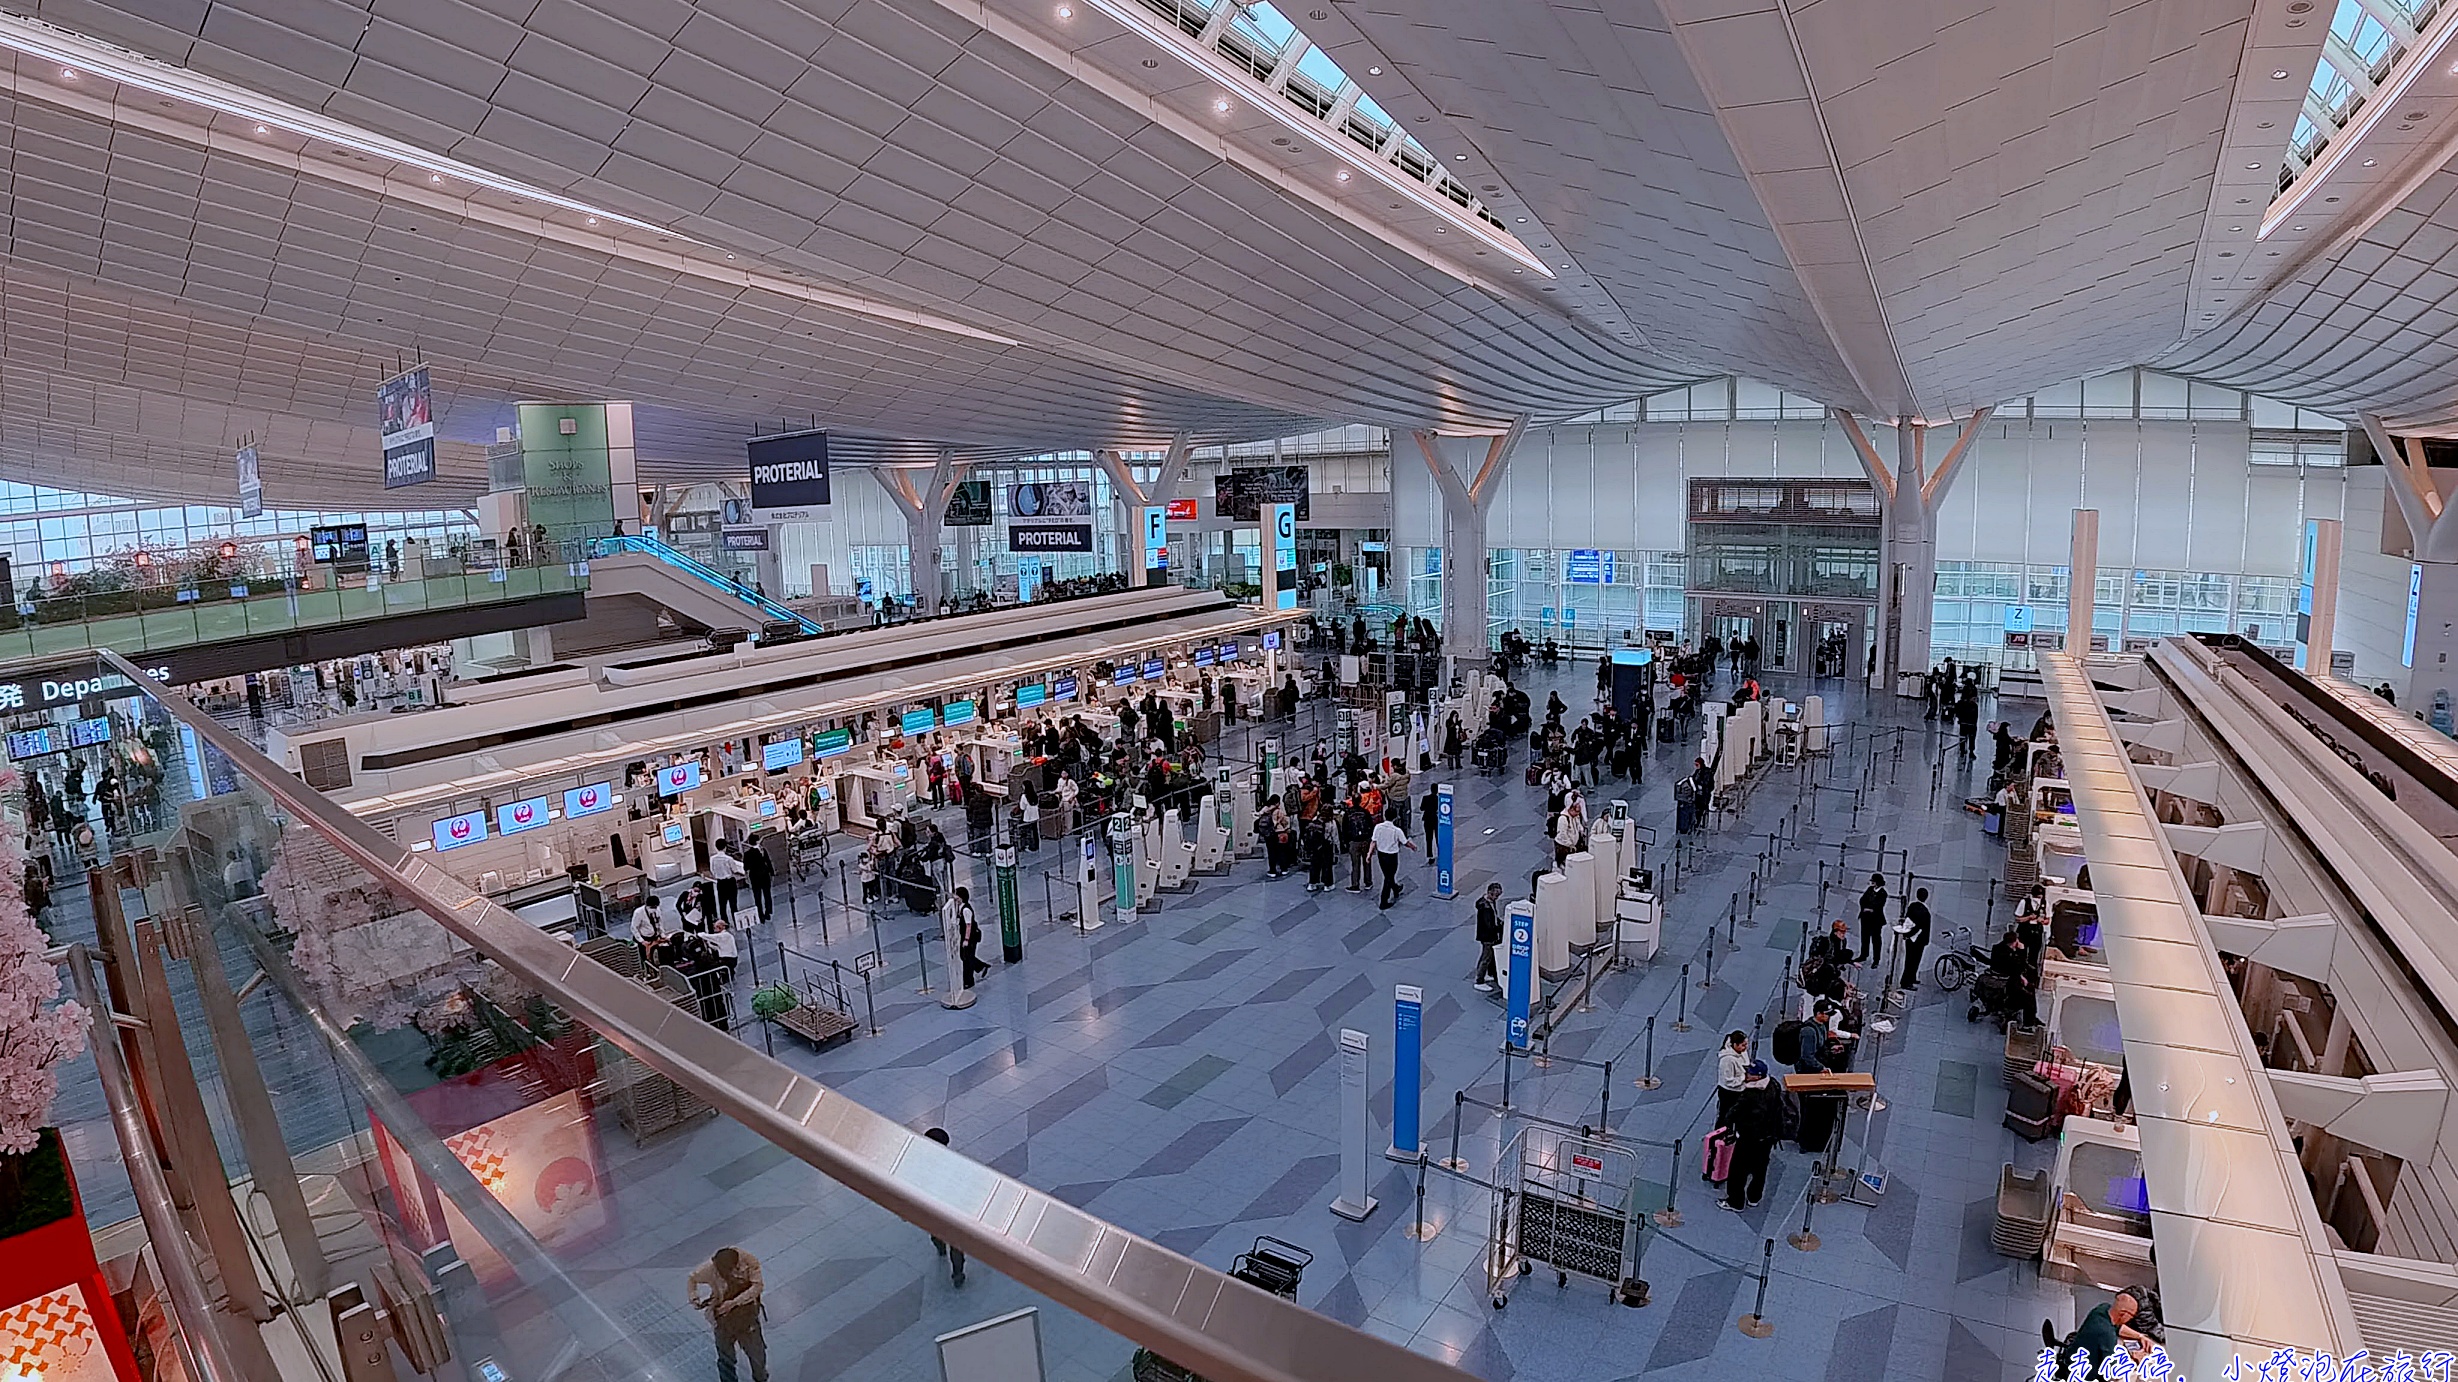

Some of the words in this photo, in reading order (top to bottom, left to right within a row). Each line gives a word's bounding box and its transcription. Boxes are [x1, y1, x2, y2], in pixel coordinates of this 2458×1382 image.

[387, 450, 428, 480] PROTERIAL
[753, 459, 823, 485] PROTERIAL
[530, 483, 608, 498] RESTAURANTS
[1150, 513, 1160, 539] F
[1278, 511, 1292, 539] G
[726, 534, 764, 548] PROTERIAL
[1018, 531, 1082, 546] PROTERIAL
[371, 545, 380, 555] A
[2411, 570, 2420, 597] Z
[2014, 608, 2023, 619] Z
[1300, 627, 1307, 640] G
[41, 666, 170, 701] Depaes
[408, 692, 416, 700] B
[1430, 689, 1436, 699] 2
[1221, 771, 1227, 781] 1
[1617, 807, 1623, 818] 1
[1114, 818, 1121, 830] 2
[1124, 818, 1130, 830] 2
[1514, 920, 1529, 928] STEP
[1518, 930, 1525, 941] 2
